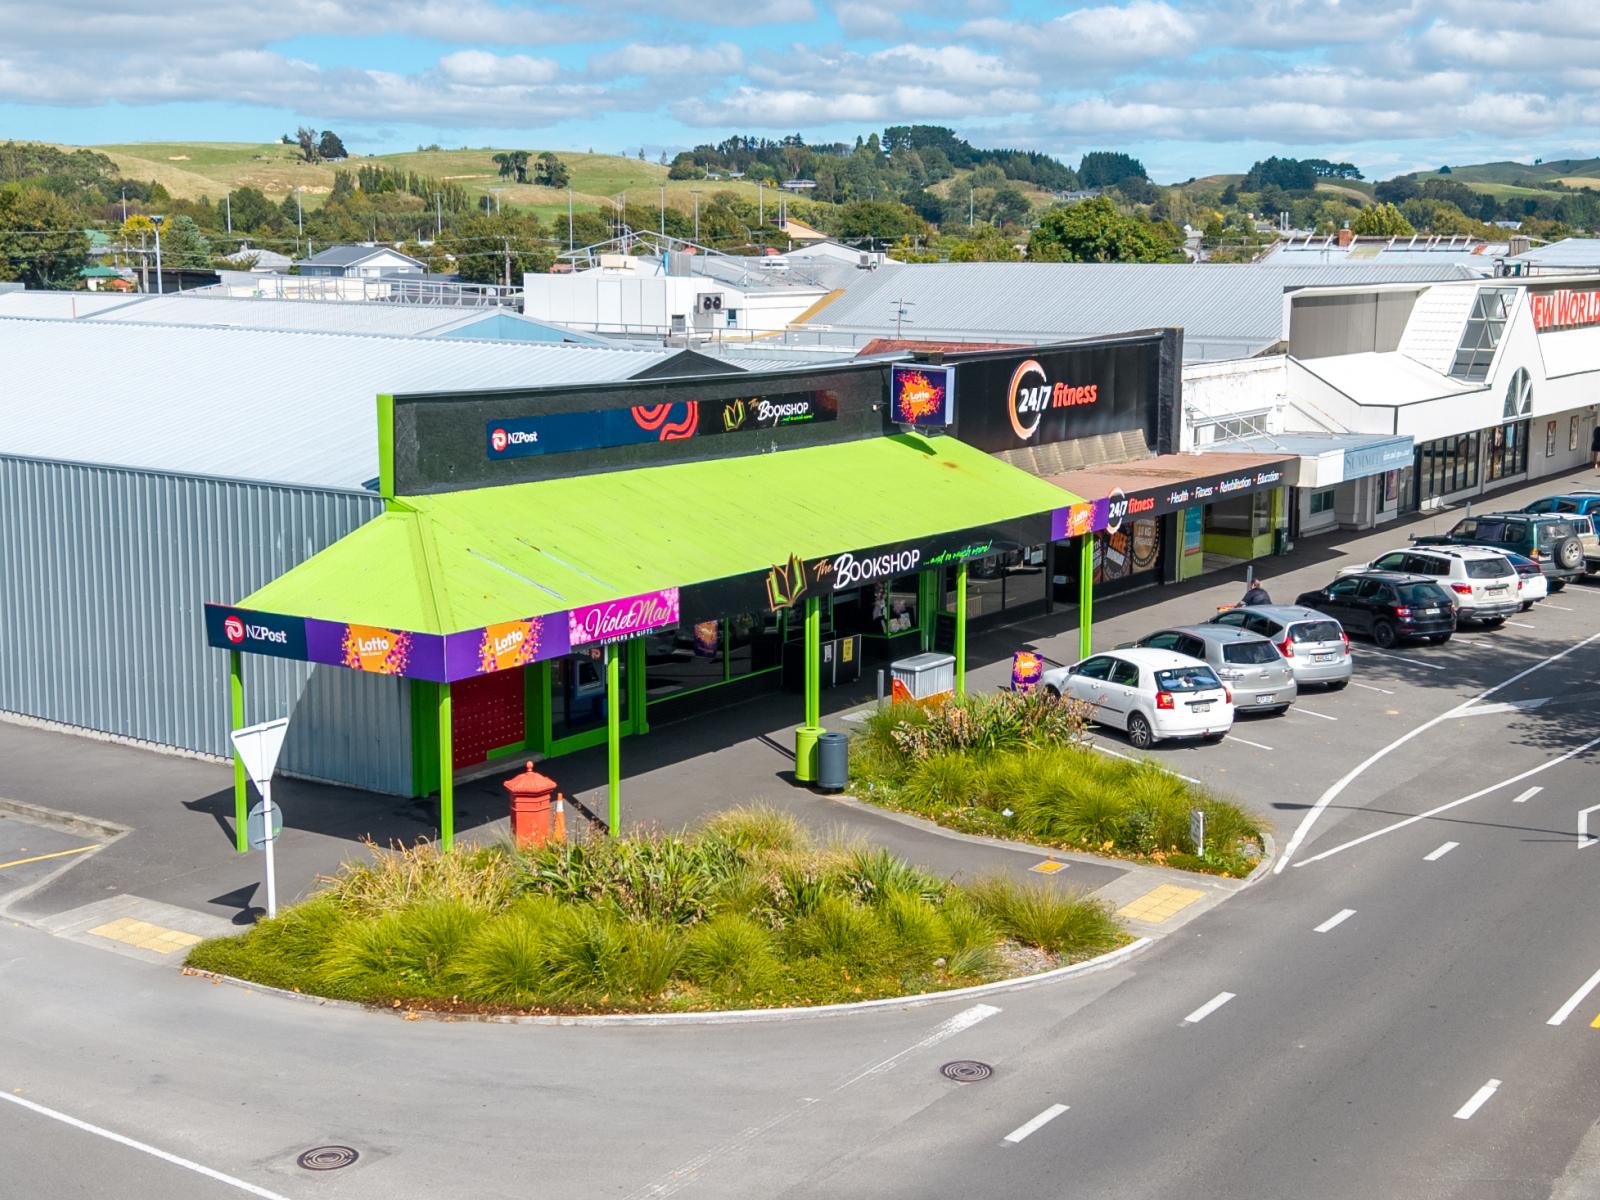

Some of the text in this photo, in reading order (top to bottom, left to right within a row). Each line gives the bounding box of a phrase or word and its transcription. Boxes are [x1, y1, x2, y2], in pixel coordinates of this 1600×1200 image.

[1556, 288, 1600, 325] WORLD
[910, 391, 929, 401] Lotto
[1018, 382, 1098, 413] 24/7 fitness
[757, 400, 809, 422] BOOKSHOP
[507, 431, 539, 445] NZPost
[1170, 470, 1280, 504] Health Fitness Rehabilitation Education
[1073, 509, 1089, 522] Lotto
[1108, 497, 1155, 519] 24/7 fitness
[813, 549, 921, 590] The BOOKSHOP
[245, 624, 288, 643] NZPost
[494, 631, 523, 652] Lotto
[357, 638, 390, 652] Lotto
